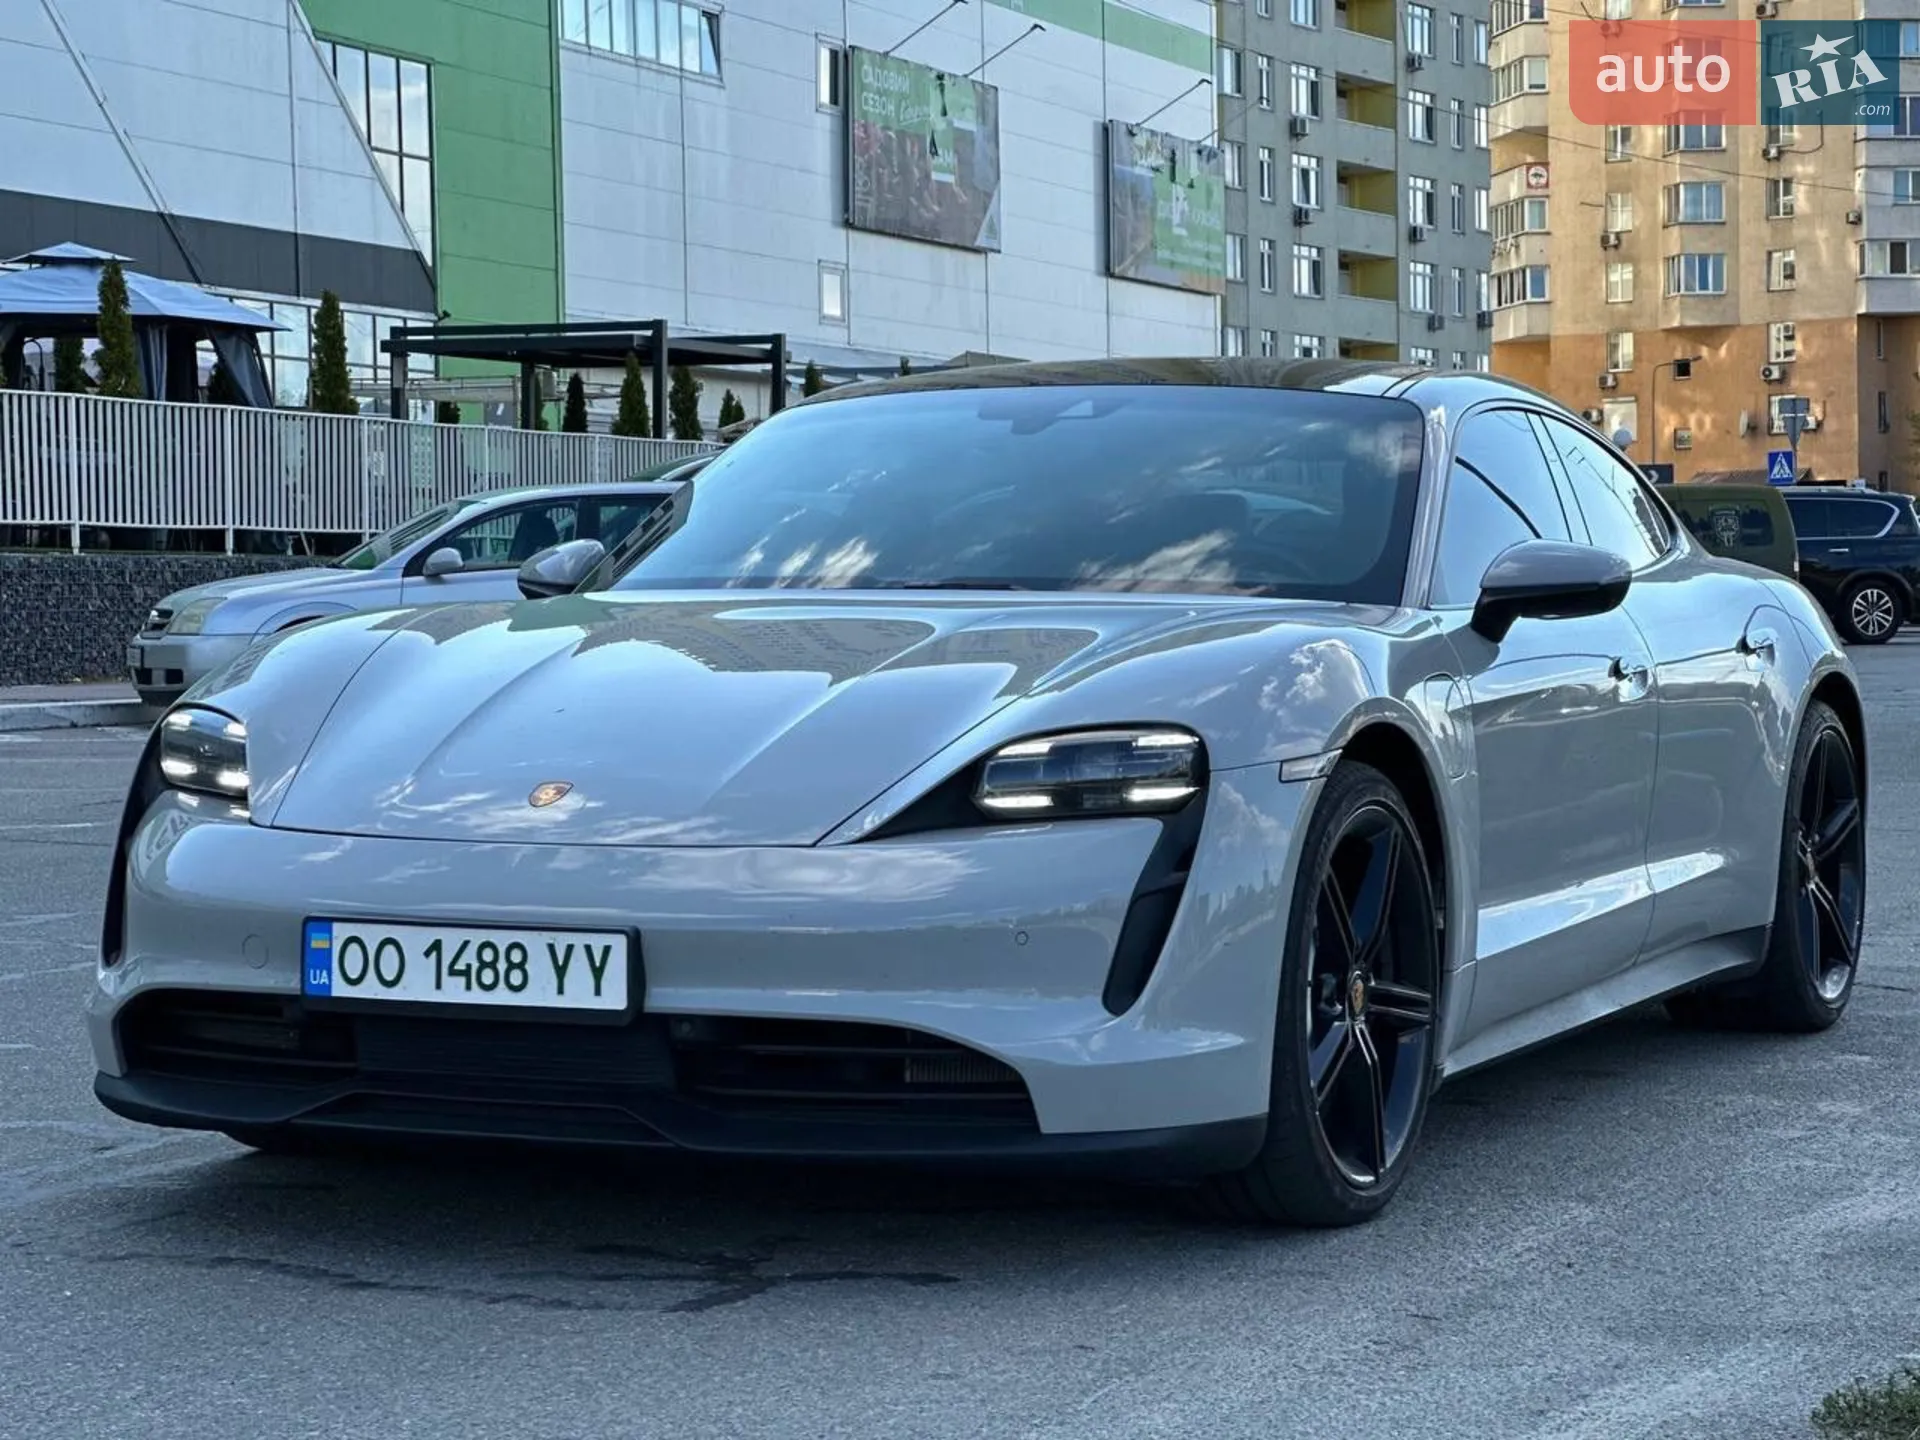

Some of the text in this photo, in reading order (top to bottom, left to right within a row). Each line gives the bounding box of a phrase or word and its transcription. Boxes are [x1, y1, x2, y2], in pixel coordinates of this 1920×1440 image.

[861, 91, 895, 117] СЕЗОН
[310, 969, 330, 985] UA
[338, 935, 612, 997] OO 1488 YY
